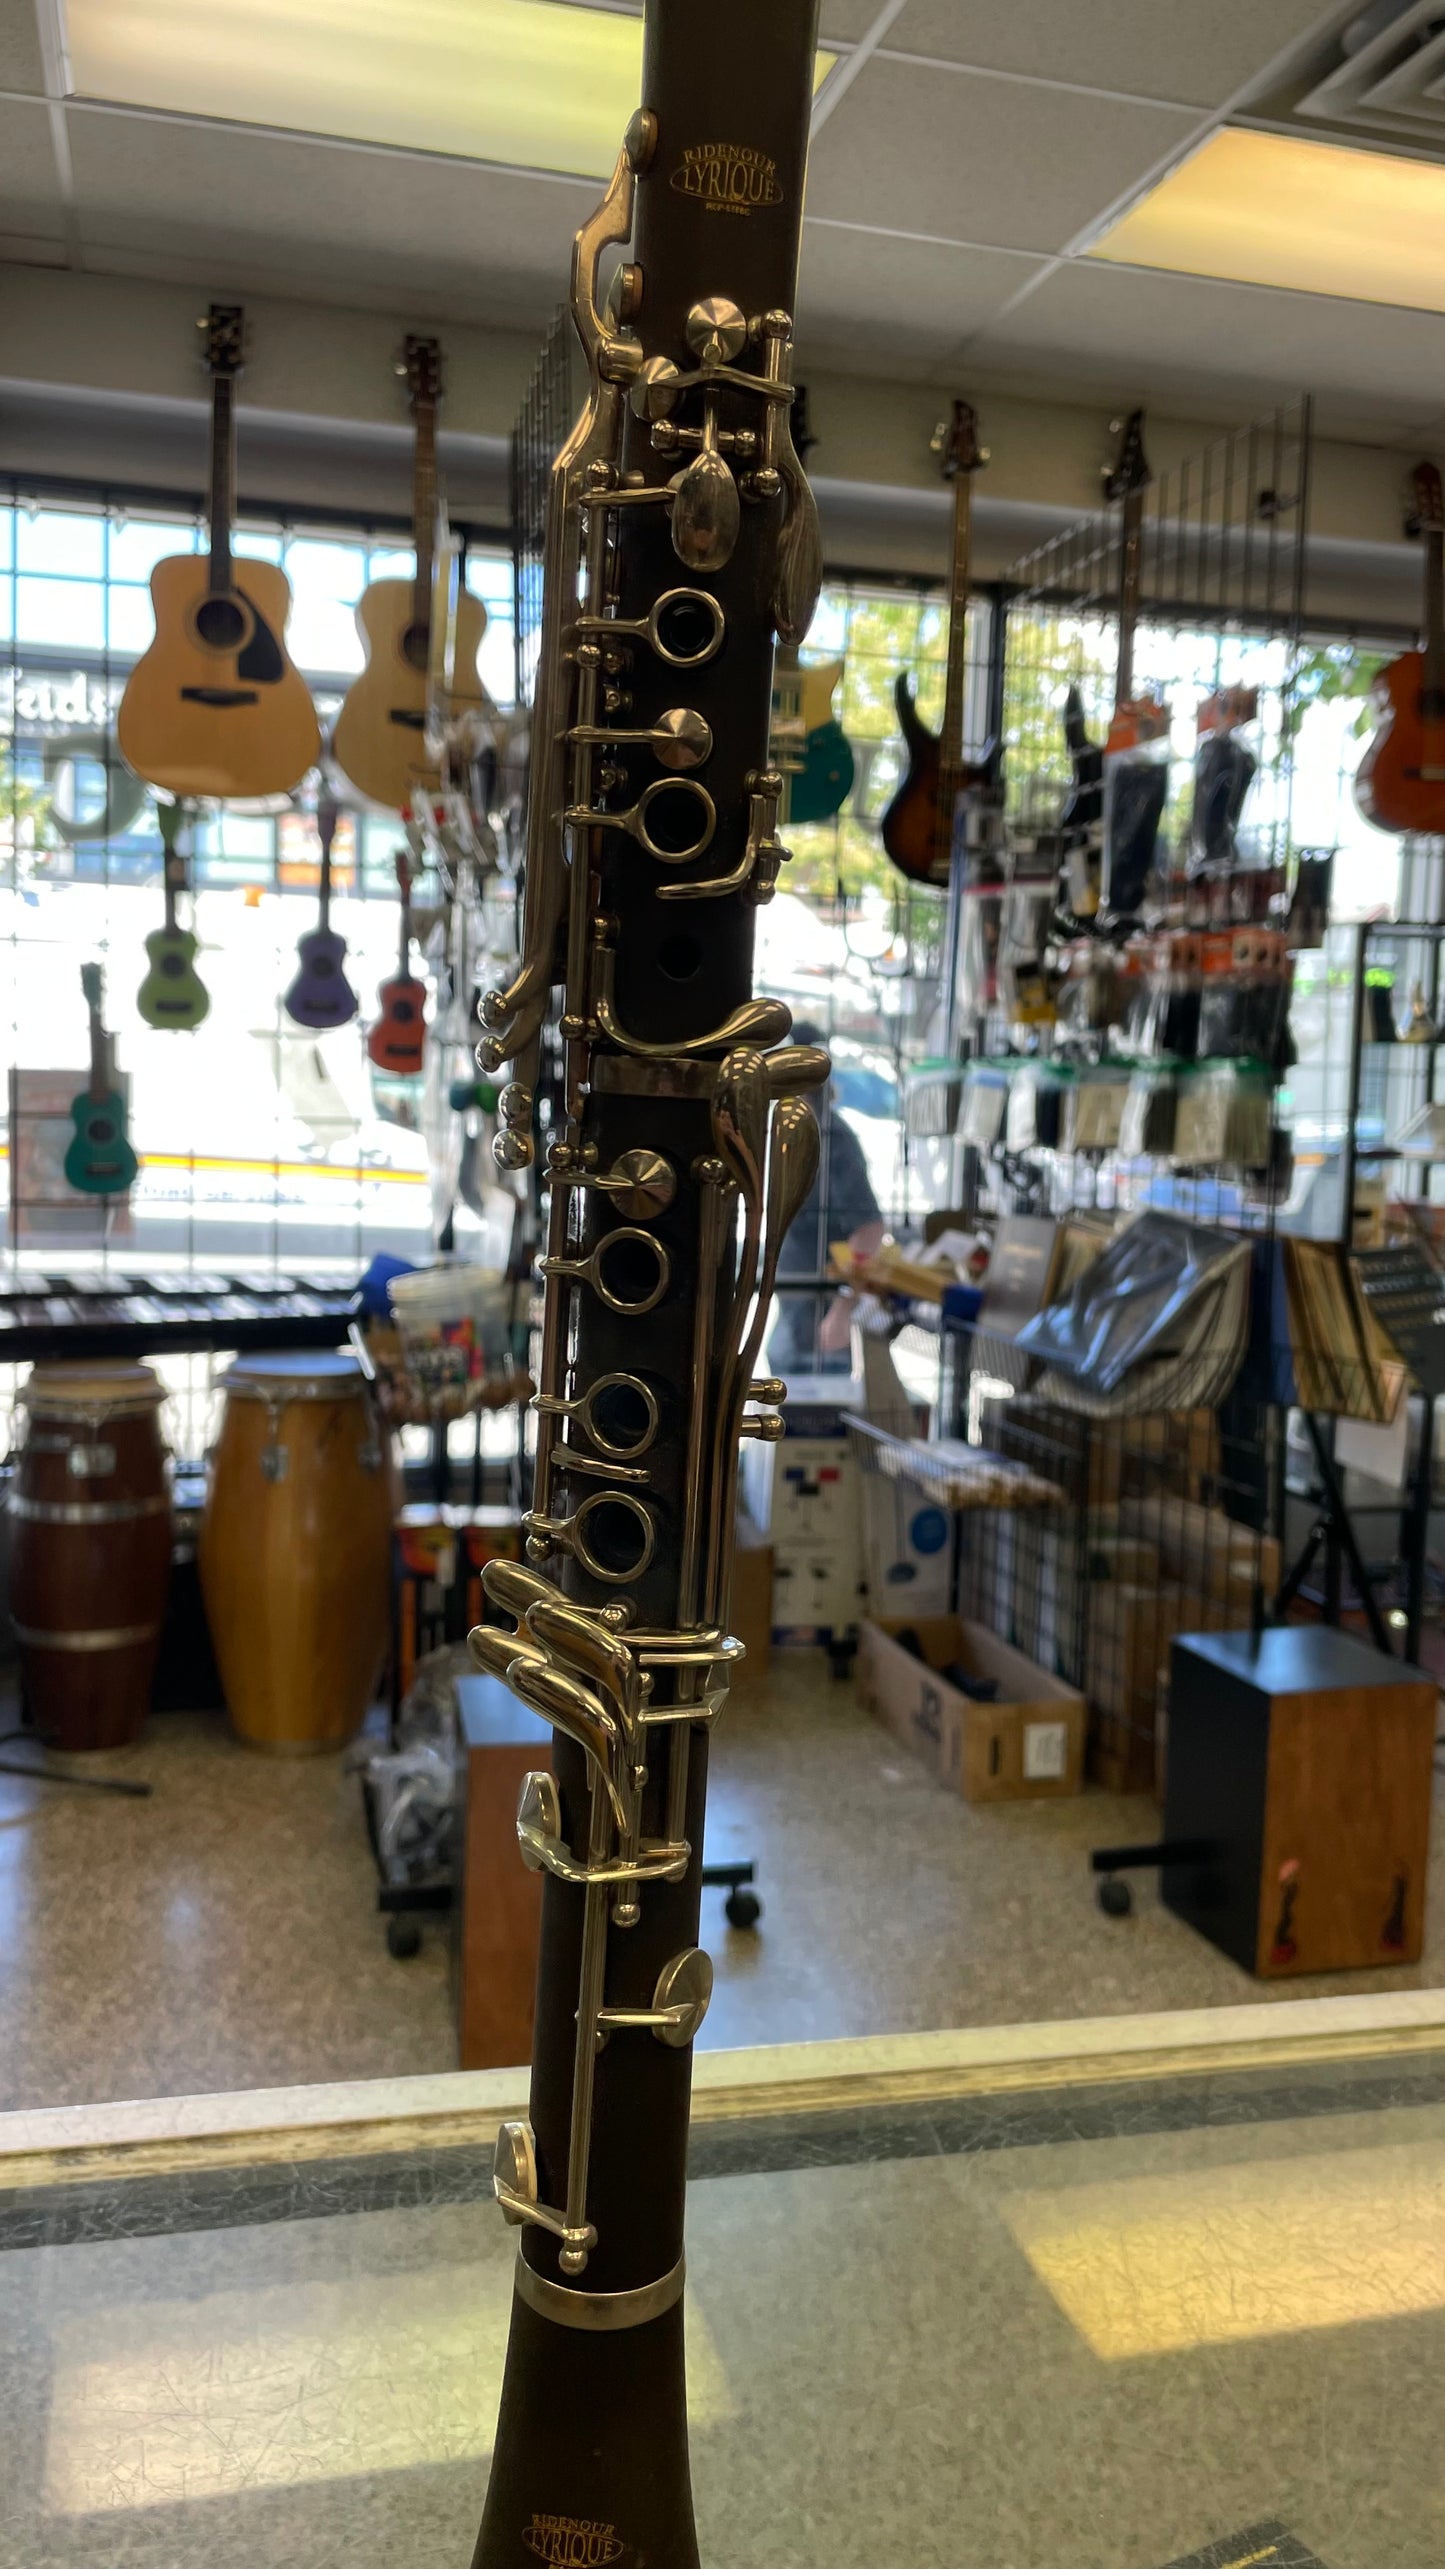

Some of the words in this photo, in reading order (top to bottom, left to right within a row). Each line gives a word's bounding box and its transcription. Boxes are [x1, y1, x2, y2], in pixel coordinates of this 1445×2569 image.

[683, 143, 777, 176] RIDENOUR
[683, 160, 775, 203] LYRIQUE
[531, 2513, 616, 2535] RIDENOUR
[531, 2529, 615, 2565] LYRIQUE
